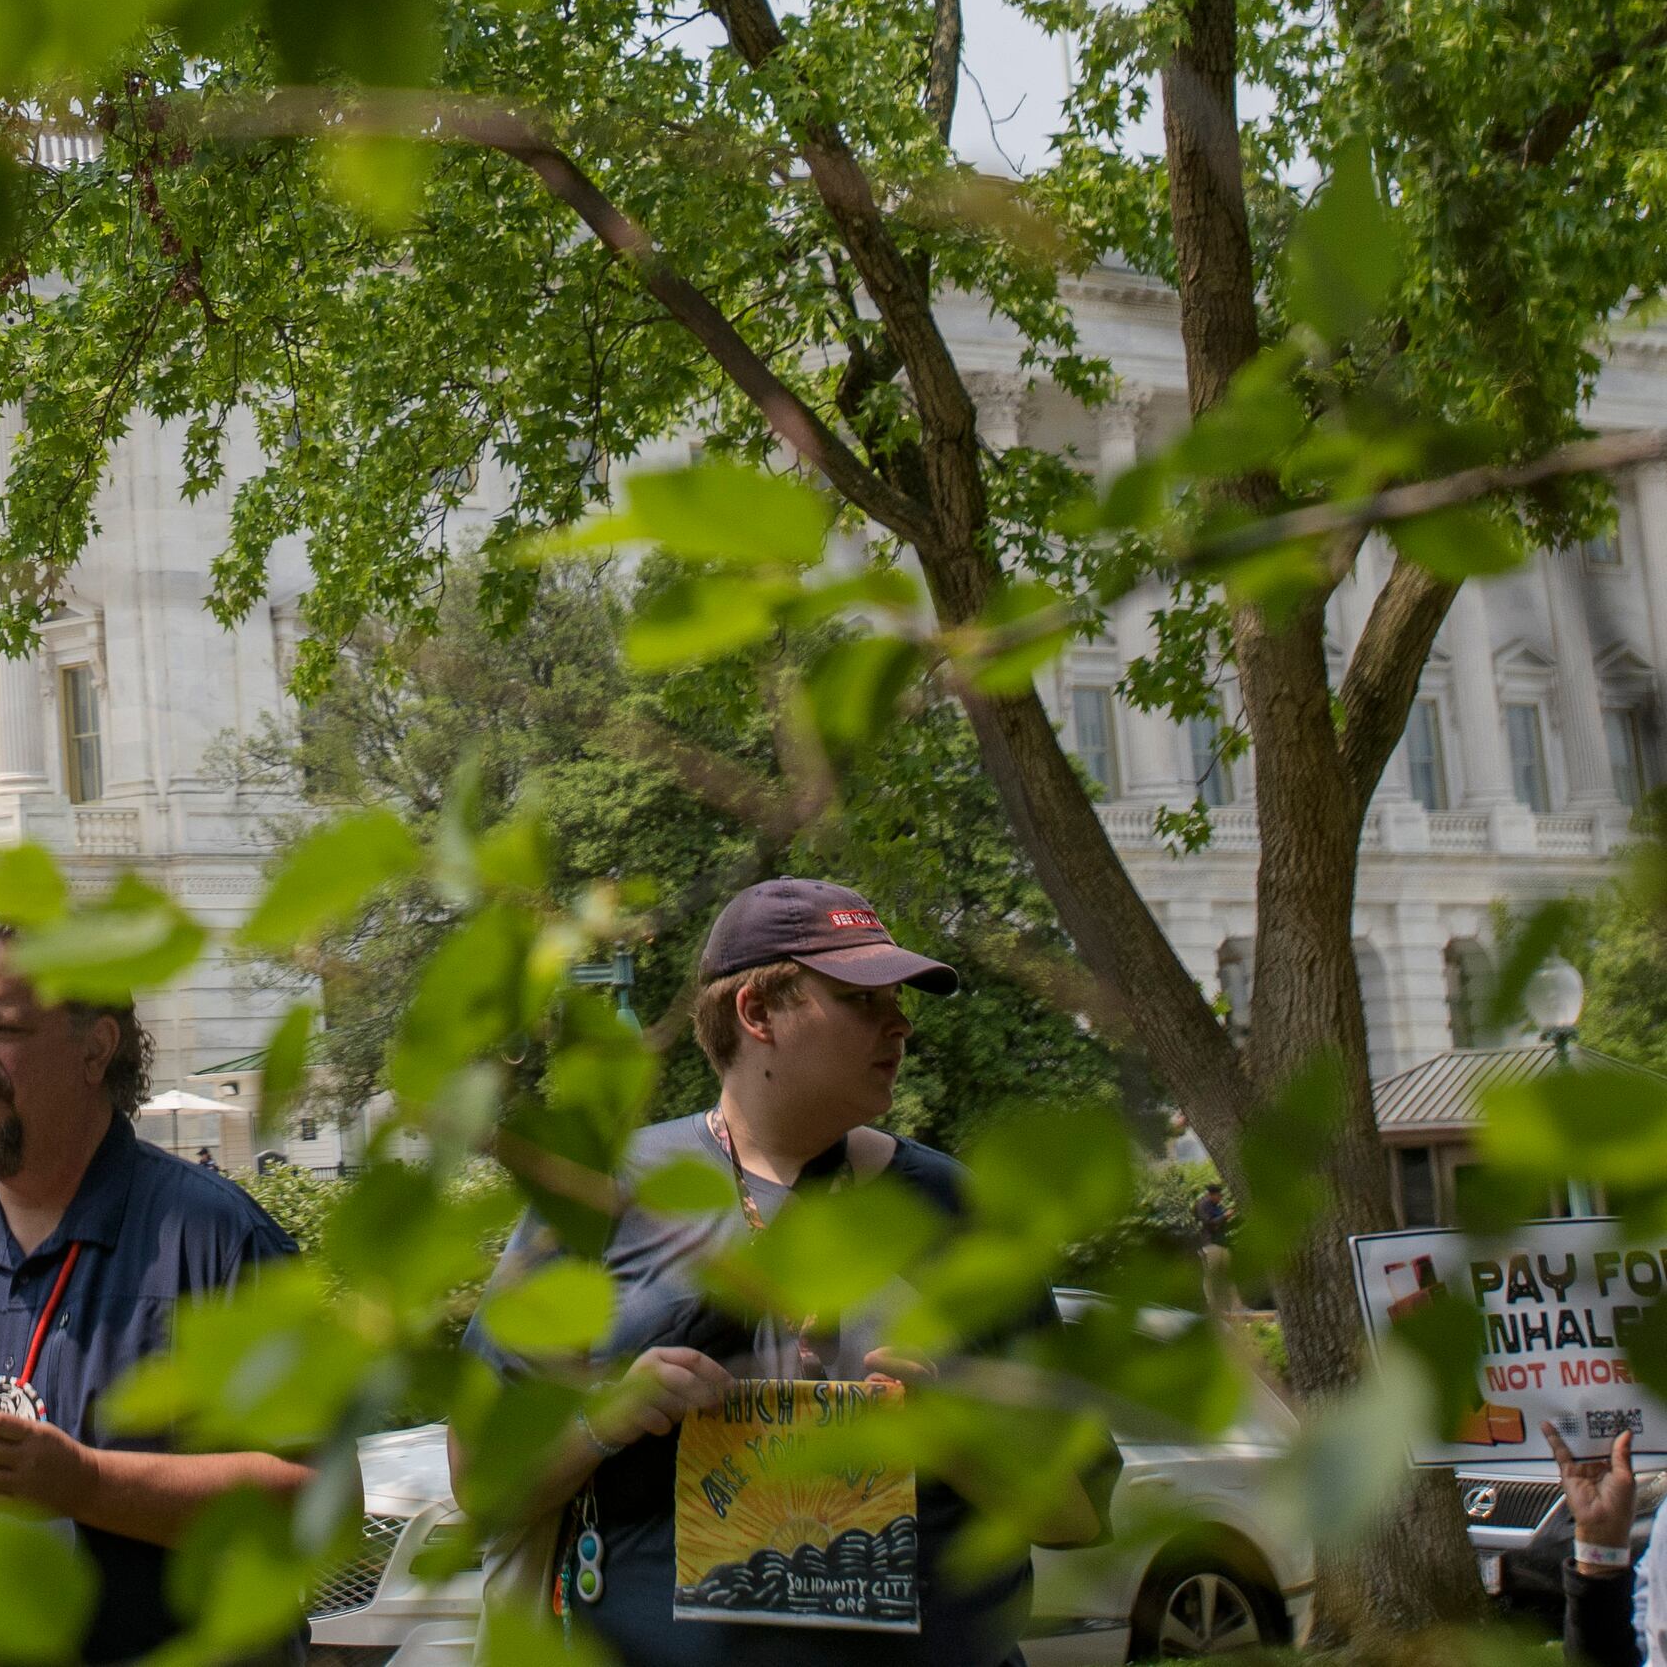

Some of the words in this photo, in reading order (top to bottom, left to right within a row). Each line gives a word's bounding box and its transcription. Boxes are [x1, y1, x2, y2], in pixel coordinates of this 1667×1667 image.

[831, 913, 854, 925] SEE
[1470, 1252, 1577, 1307] PAY
[1593, 1248, 1667, 1298] FO
[1485, 1362, 1547, 1393] NOT
[1560, 1359, 1637, 1387] MOR
[787, 1572, 867, 1597] SOLIDARITY
[871, 1580, 913, 1597] CITY
